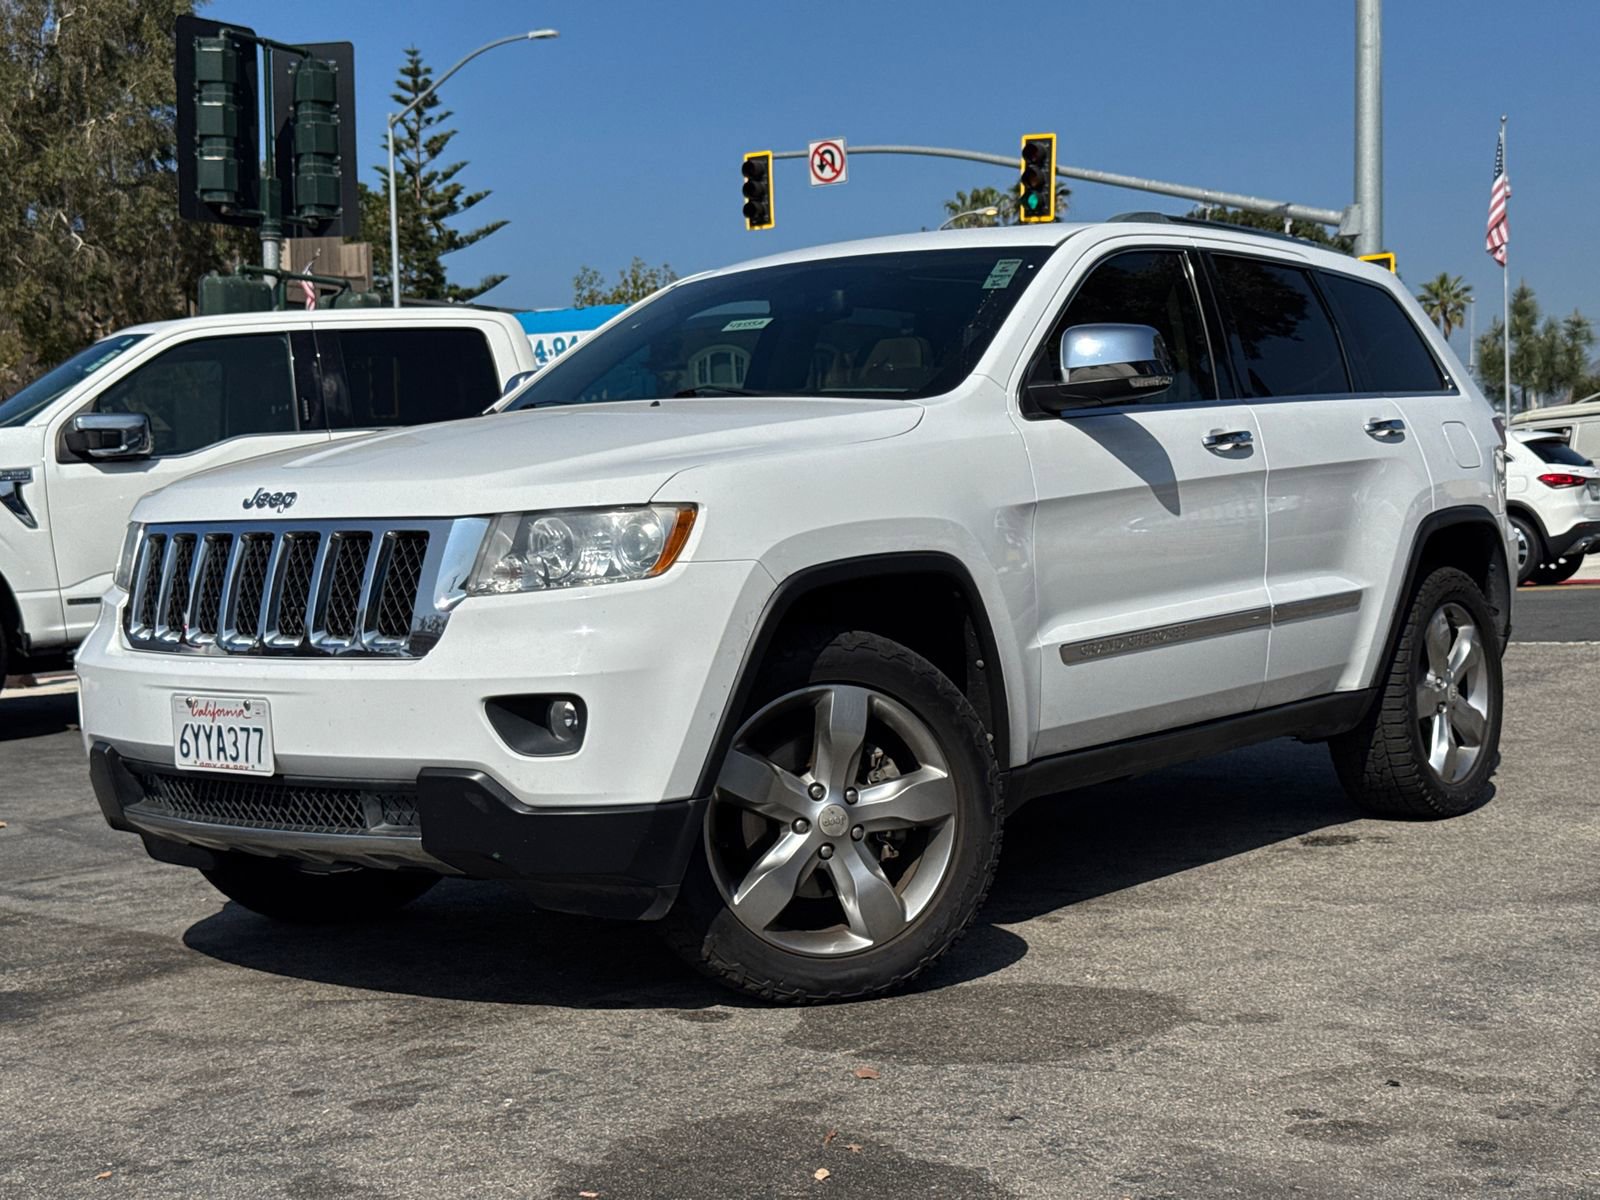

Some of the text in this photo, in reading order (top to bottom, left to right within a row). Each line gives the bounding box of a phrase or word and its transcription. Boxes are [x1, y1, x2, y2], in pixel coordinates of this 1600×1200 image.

[242, 487, 298, 513] Jeep
[191, 700, 252, 723] California
[180, 723, 264, 765] 6YYA377
